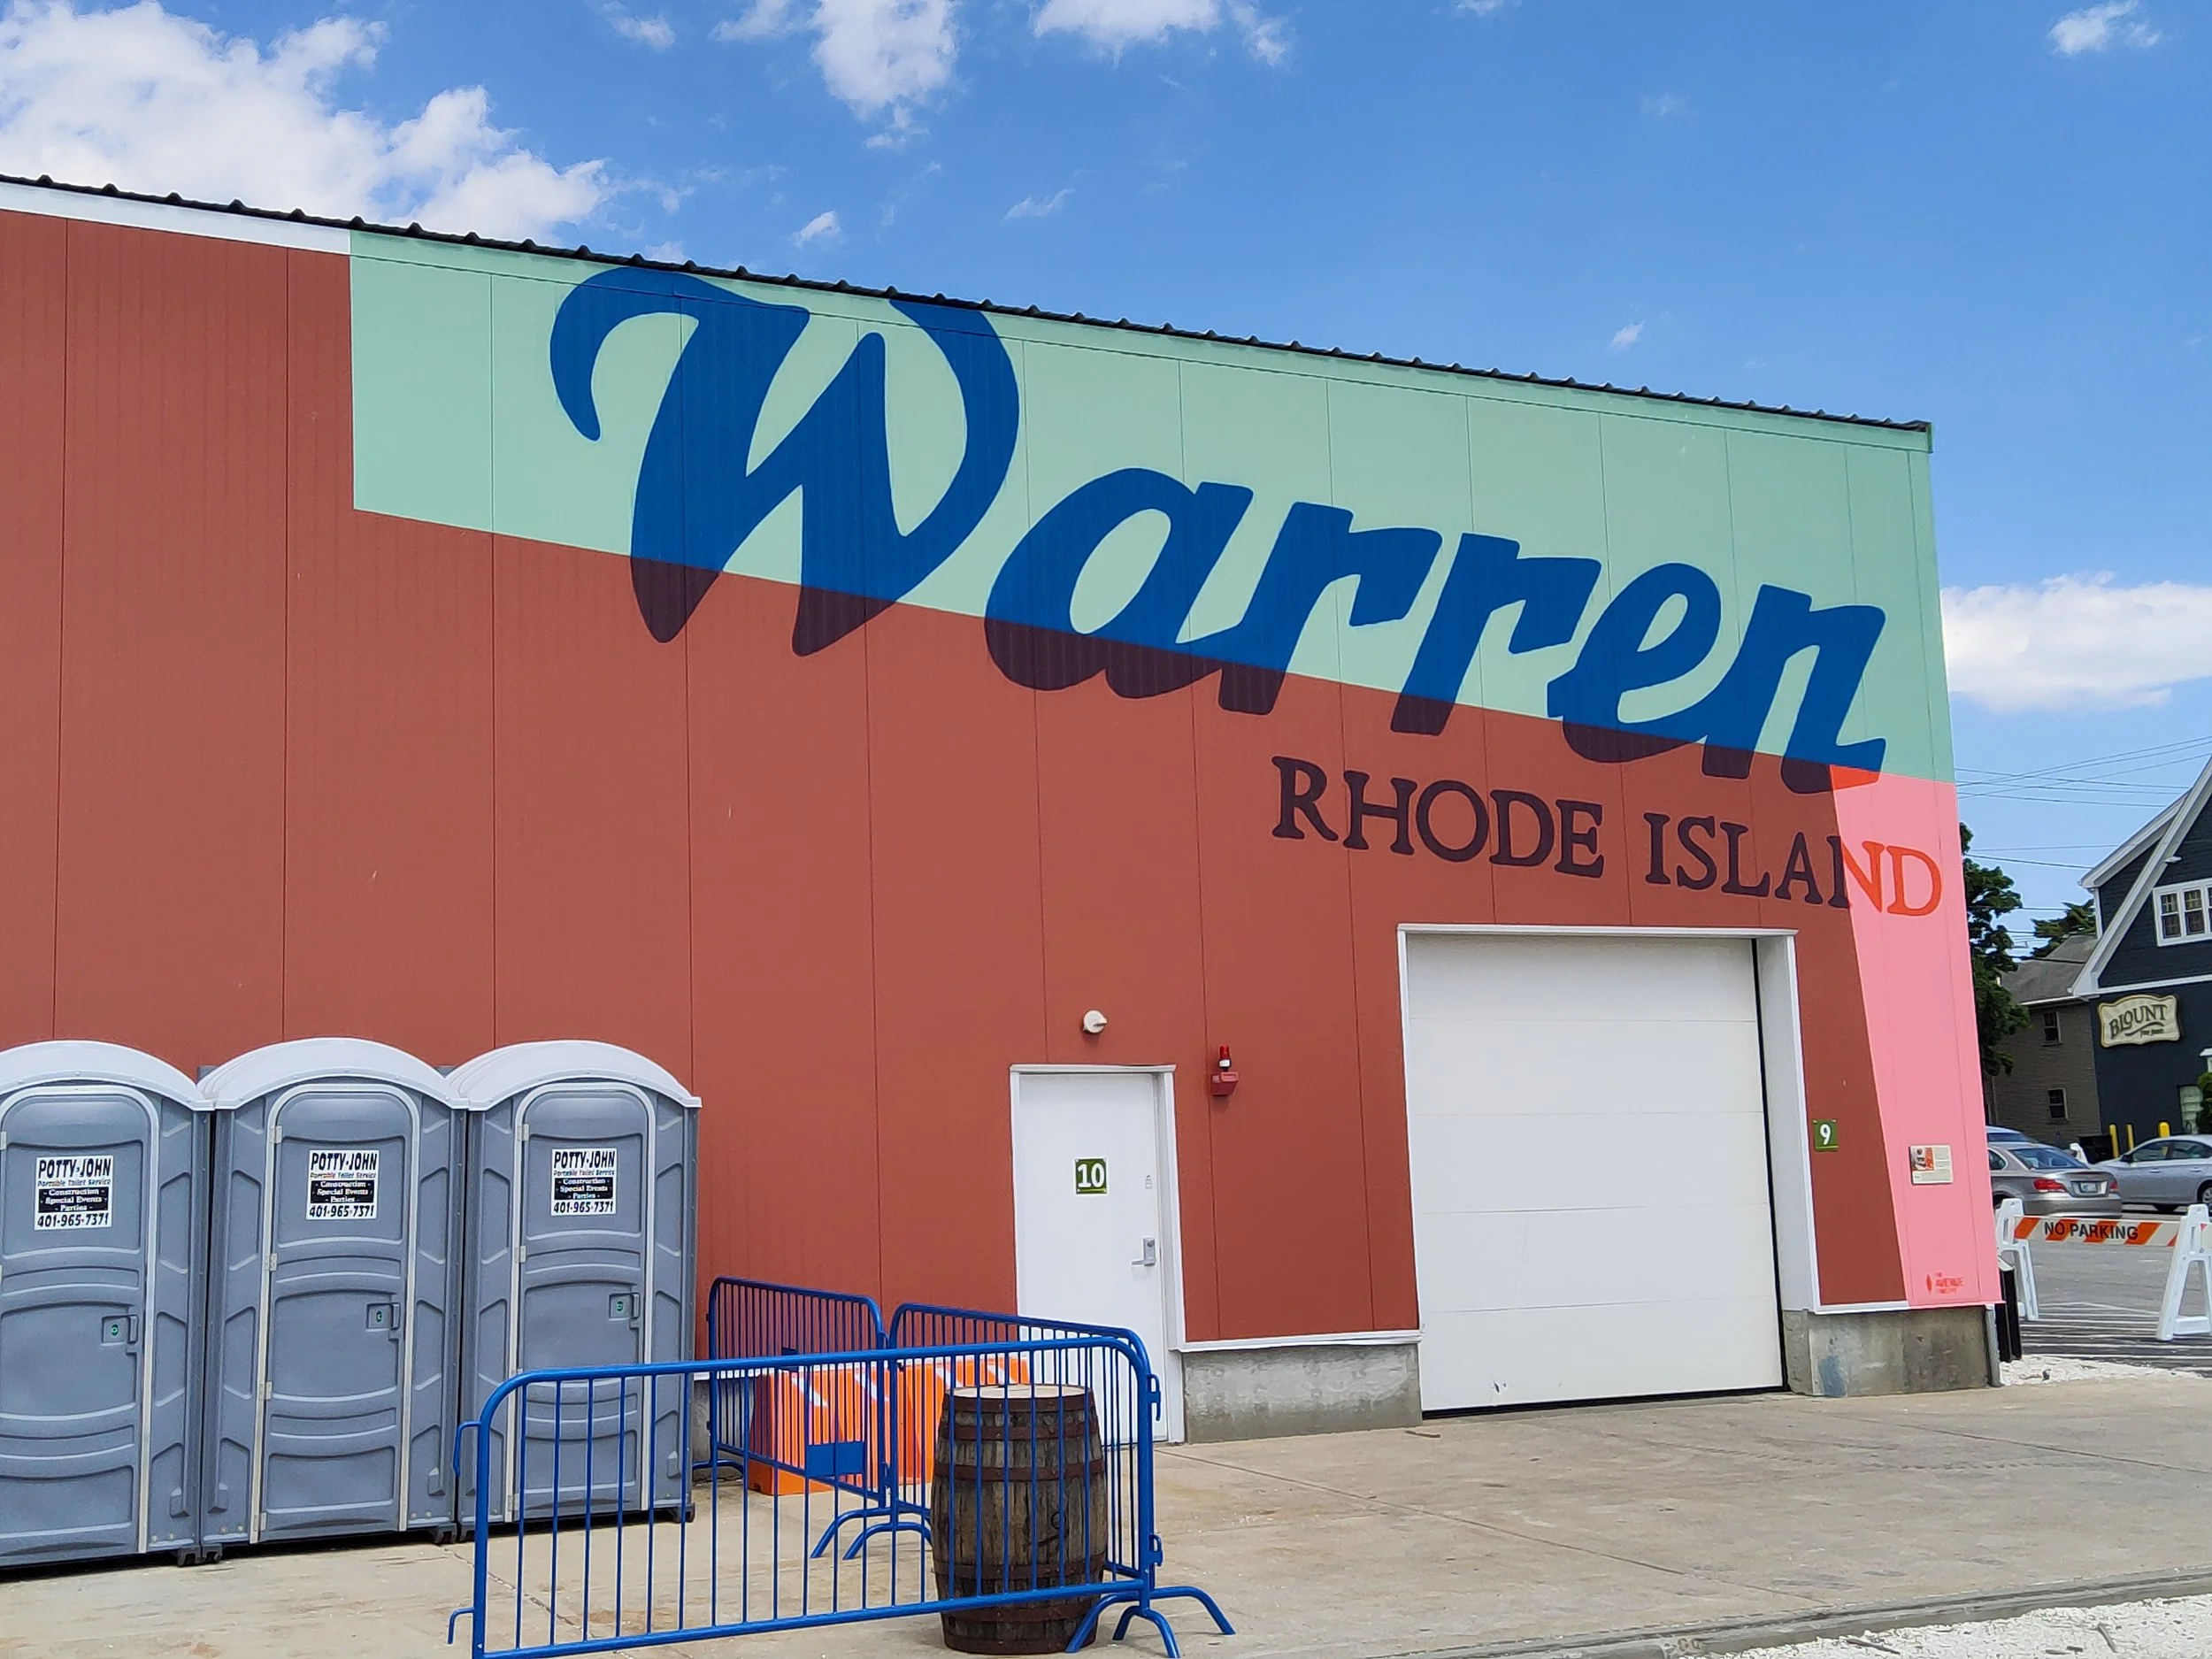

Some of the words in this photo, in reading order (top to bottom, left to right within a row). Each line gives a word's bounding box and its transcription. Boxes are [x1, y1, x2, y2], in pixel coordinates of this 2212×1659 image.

[549, 265, 1886, 794] Warren
[1271, 756, 1604, 879] RHODE
[1643, 811, 1943, 917] ISLAND
[2108, 1004, 2168, 1040] BLOUNT
[1820, 1124, 1832, 1145] 9
[1078, 1163, 1105, 1187] 10
[2045, 1221, 2065, 1236] NO
[2070, 1223, 2139, 1240] PARKING
